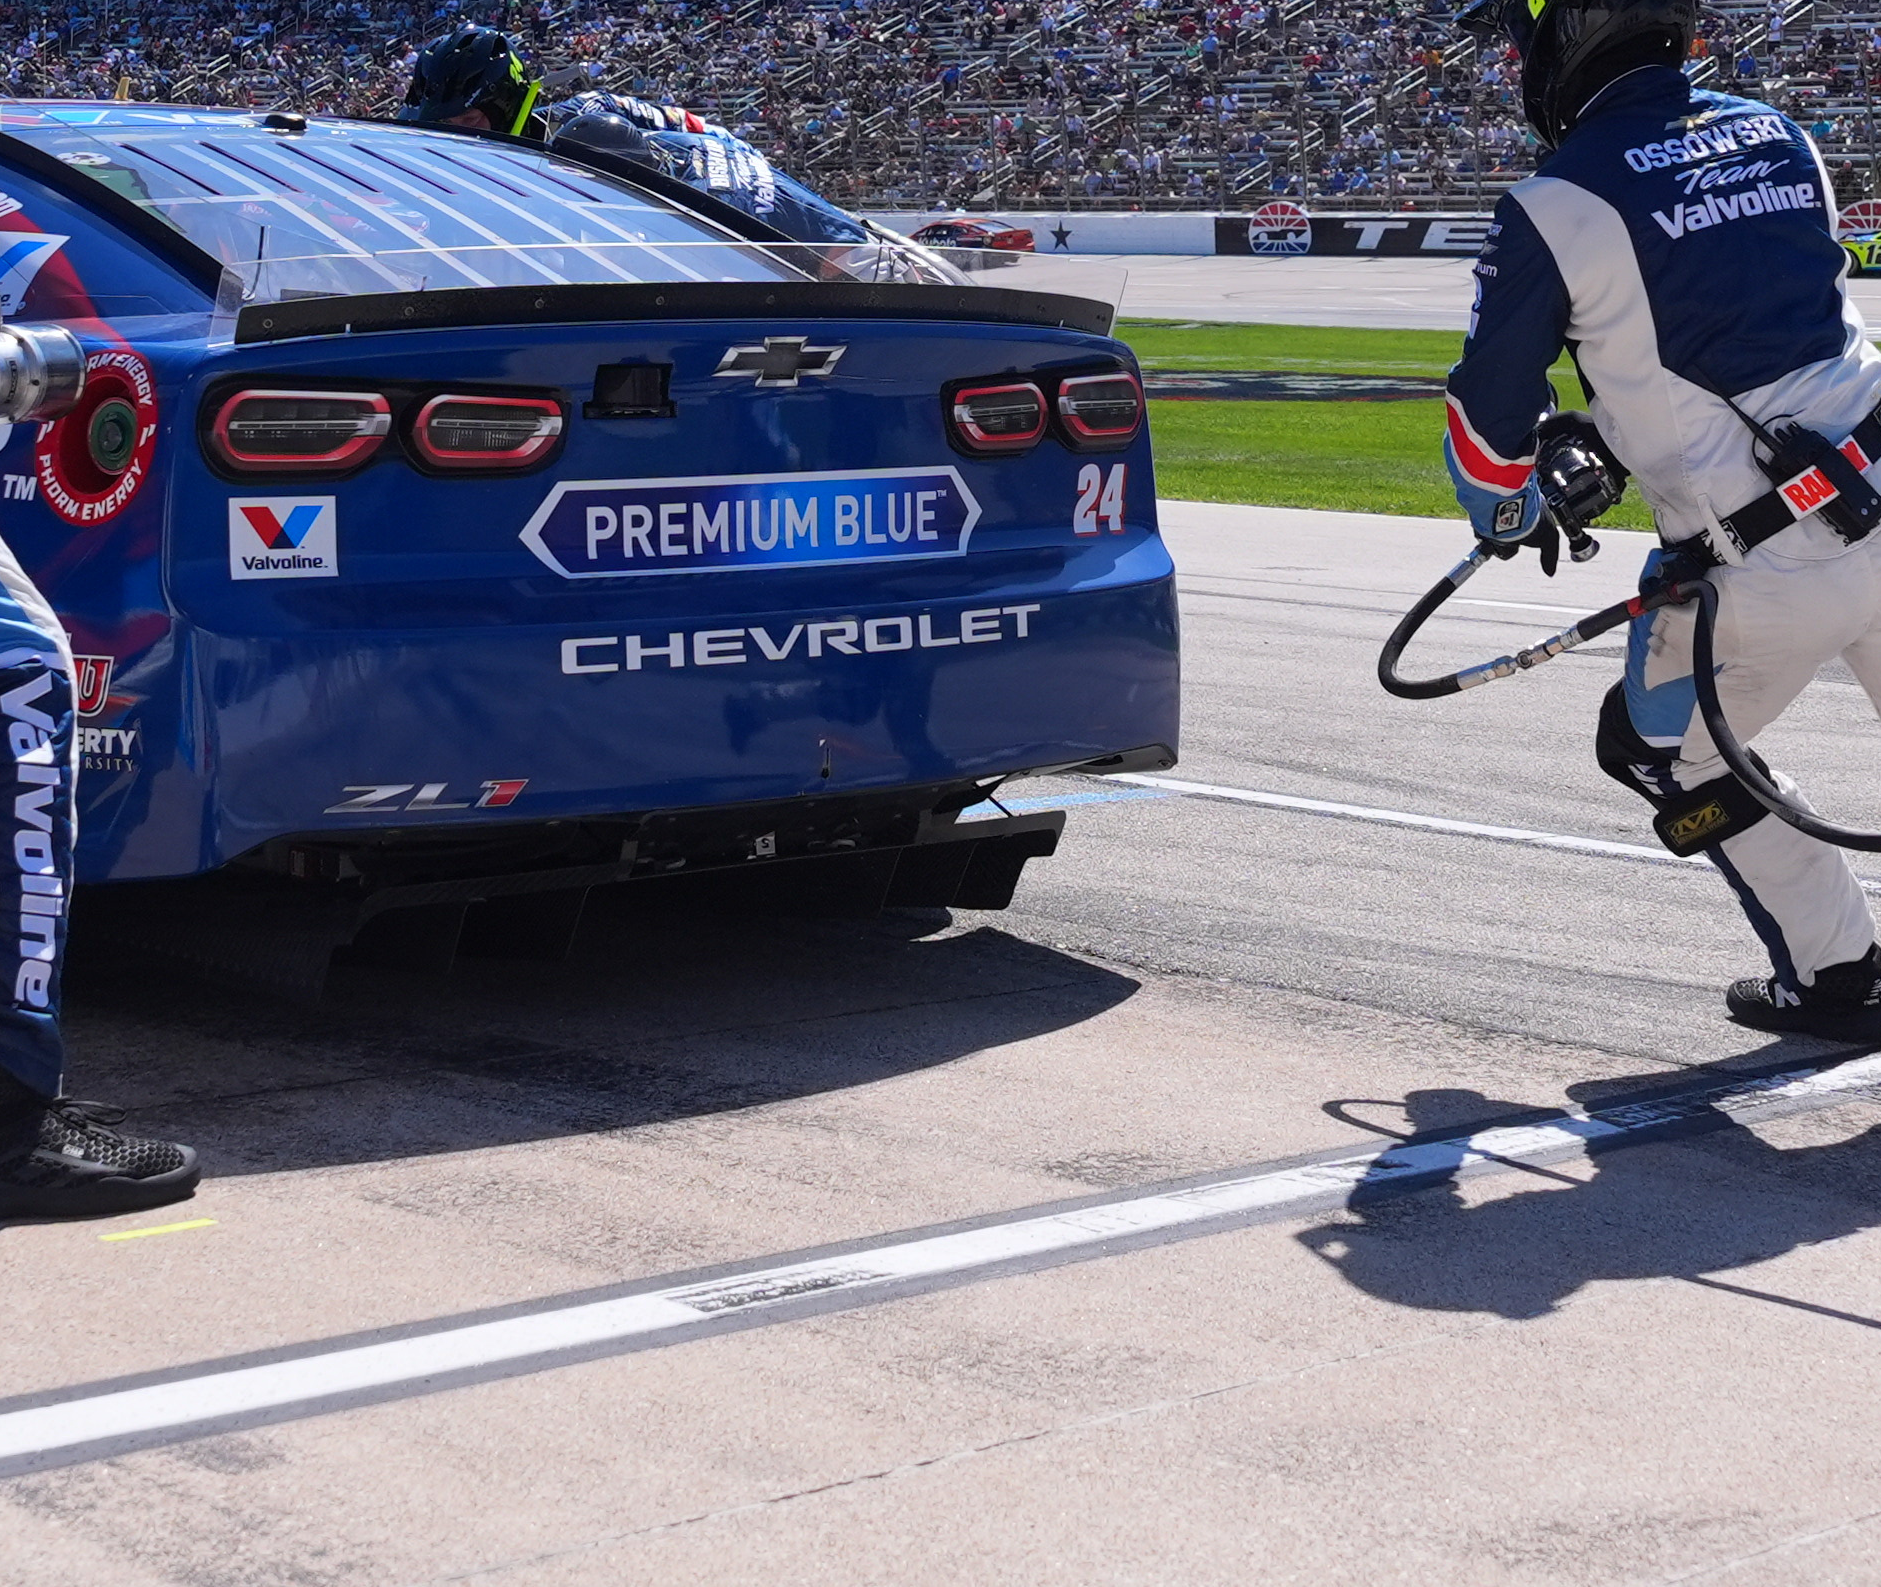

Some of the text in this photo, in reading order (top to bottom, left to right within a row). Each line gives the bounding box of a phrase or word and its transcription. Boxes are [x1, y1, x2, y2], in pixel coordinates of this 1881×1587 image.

[1623, 115, 1791, 174] OSSOWSKI
[1674, 154, 1791, 196] Team
[115, 353, 153, 406] ENERGY
[2, 474, 38, 501] TM
[39, 453, 143, 521] PHORM ENERGY
[1073, 462, 1127, 536] 24
[585, 494, 819, 560] PREMIUM
[241, 554, 328, 572] Valvoline
[560, 604, 1041, 676] CHEVROLET
[77, 726, 137, 756] ERTY
[84, 756, 135, 772] RSITY
[323, 778, 530, 815] ZL1
[1773, 982, 1802, 1009] N
